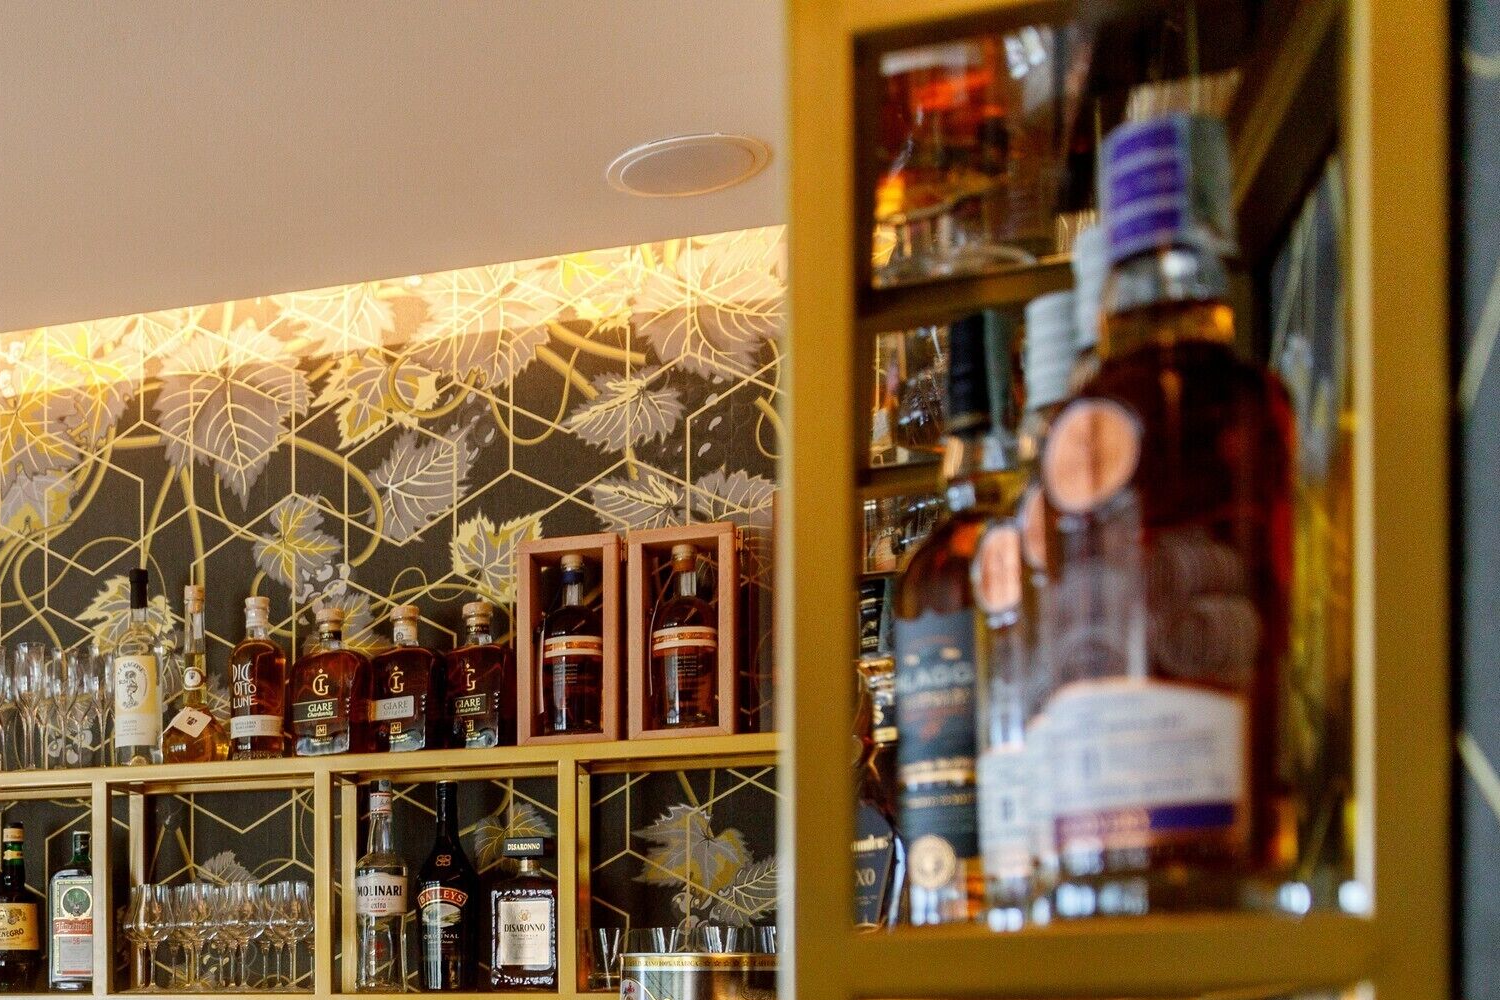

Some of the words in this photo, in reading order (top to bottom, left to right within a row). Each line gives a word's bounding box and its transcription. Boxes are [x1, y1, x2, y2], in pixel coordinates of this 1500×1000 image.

[233, 693, 258, 709] LUNE
[307, 701, 333, 712] GIARE
[383, 699, 408, 710] GIARE
[507, 843, 541, 851] DISARONNO
[419, 889, 466, 904] BAILEYS
[504, 923, 546, 933] DISARONNO
